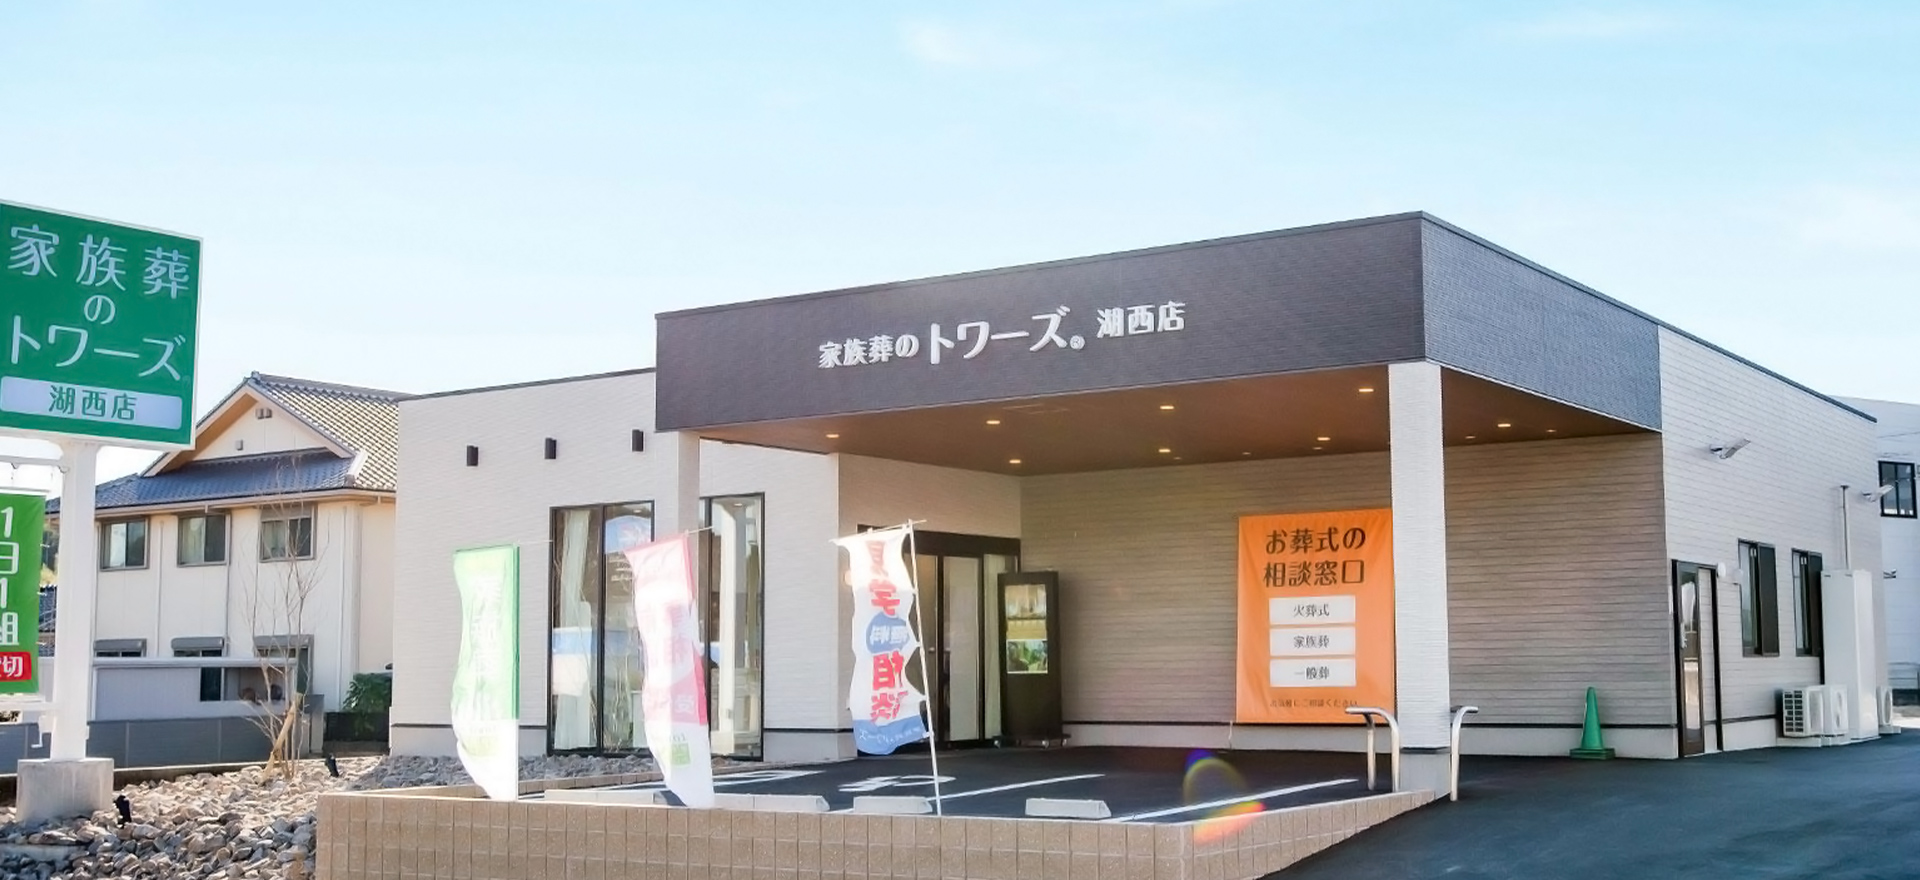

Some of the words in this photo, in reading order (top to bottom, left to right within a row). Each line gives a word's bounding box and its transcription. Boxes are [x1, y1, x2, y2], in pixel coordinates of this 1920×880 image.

[8, 224, 191, 299] 家族葬
[83, 294, 116, 325] の
[1096, 301, 1186, 339] 湖西店
[11, 315, 186, 381] トワーズ
[48, 384, 137, 420] 湖西店
[1265, 527, 1366, 555] お葬式の
[1263, 560, 1365, 588] 相談窓口
[1293, 603, 1330, 617] 火葬式
[1293, 635, 1330, 649] 家族葬
[1294, 666, 1330, 680] 一般葬
